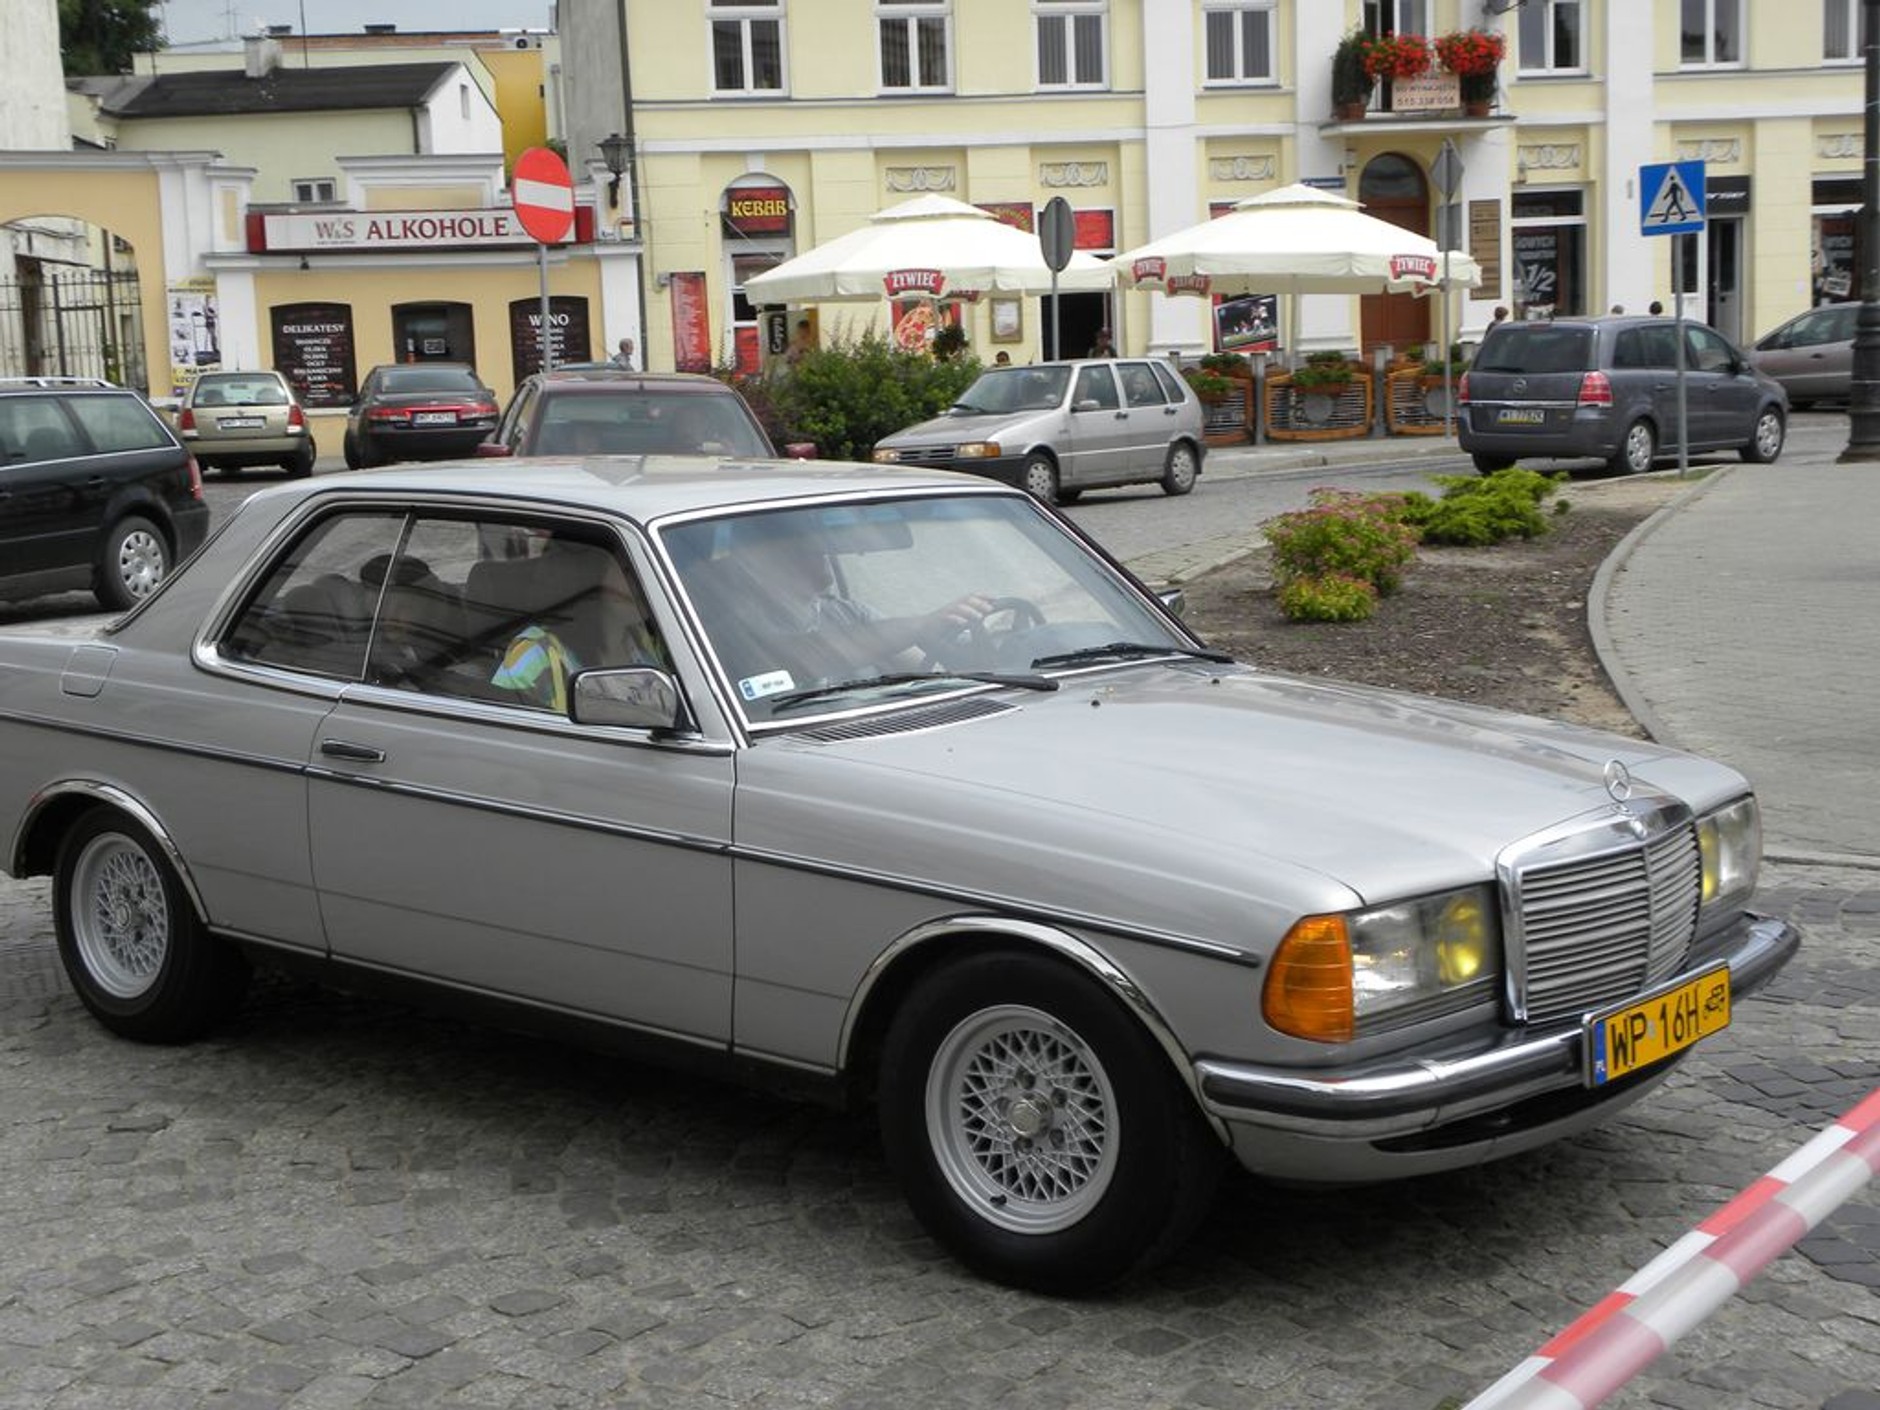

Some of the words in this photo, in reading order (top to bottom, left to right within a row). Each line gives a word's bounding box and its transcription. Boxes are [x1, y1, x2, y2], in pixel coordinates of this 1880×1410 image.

[731, 200, 788, 217] KEBAB
[366, 217, 509, 240] ALKOHOLE
[891, 271, 938, 288] ŻYWIEC
[282, 323, 345, 334] DELIKATESY
[528, 313, 569, 327] WNO
[1610, 1011, 1647, 1070] WP
[1659, 983, 1700, 1048] 16H
